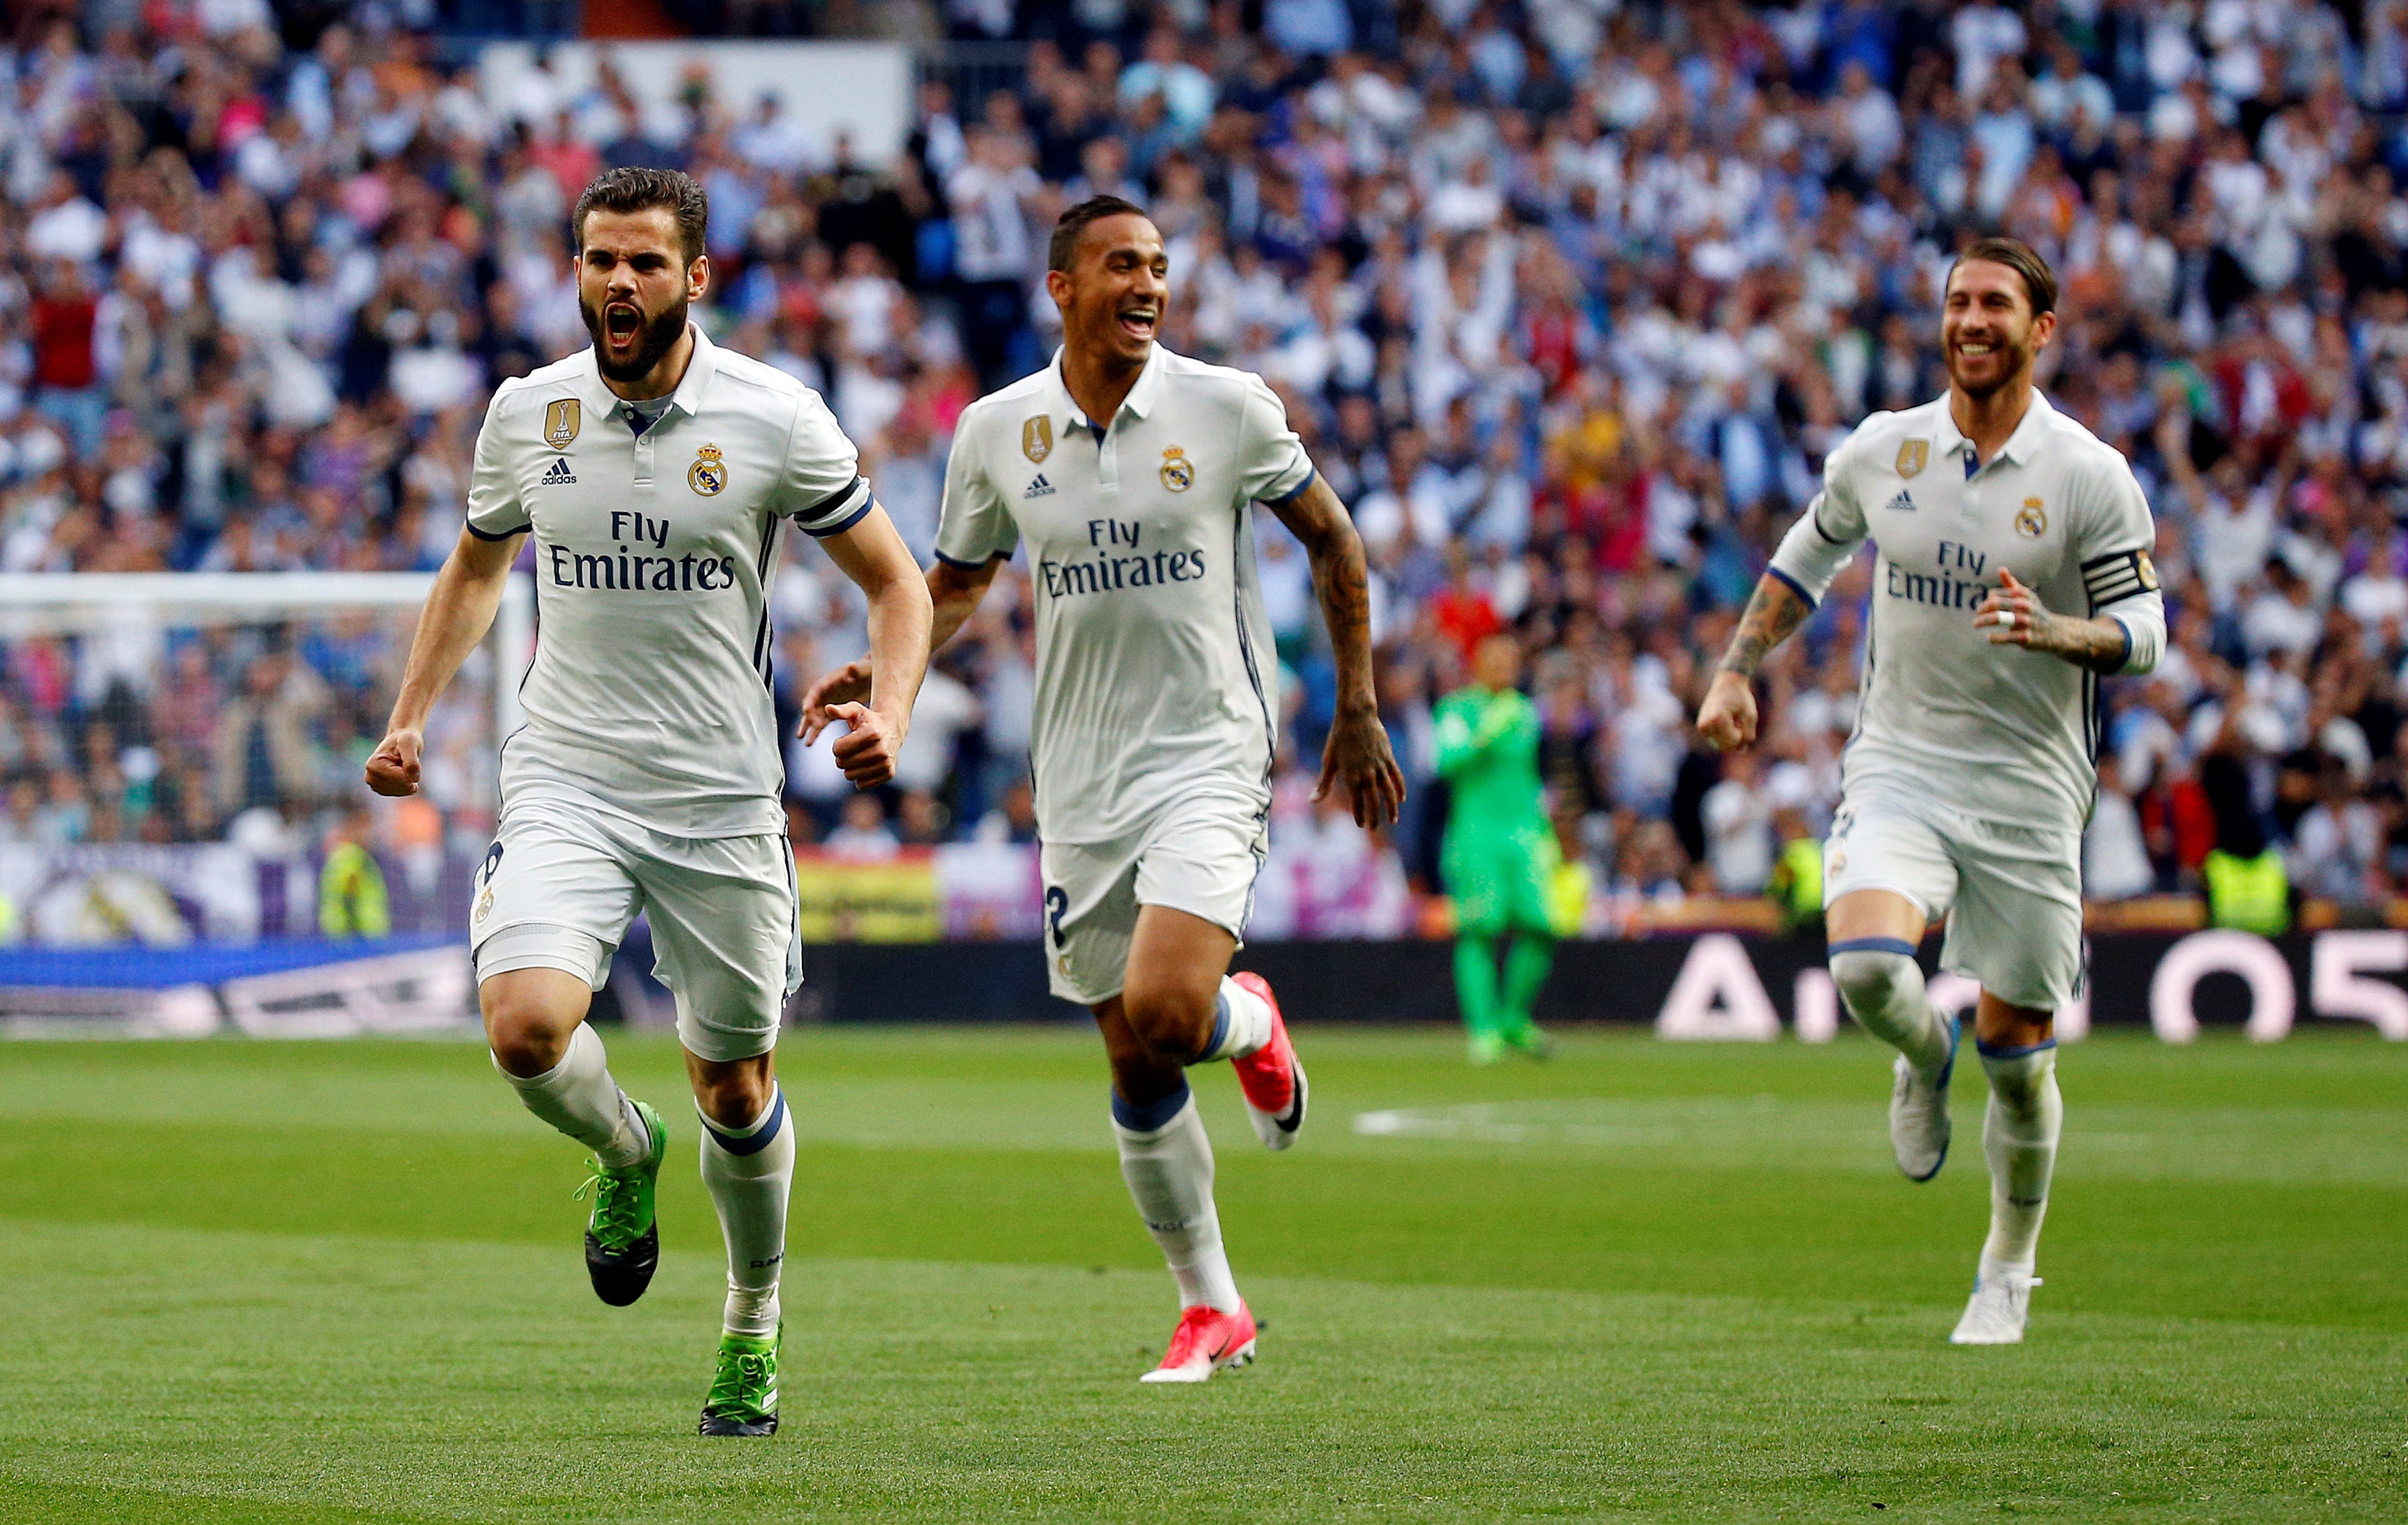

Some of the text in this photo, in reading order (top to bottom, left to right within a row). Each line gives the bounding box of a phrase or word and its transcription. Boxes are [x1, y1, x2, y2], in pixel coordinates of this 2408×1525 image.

[542, 474, 577, 485] adidas
[611, 511, 669, 549] Fly
[1088, 518, 1141, 548] Fly
[549, 544, 734, 591] Emirates
[1040, 549, 1205, 597] Emirates
[1937, 541, 1986, 576] Fly
[1888, 562, 1991, 611] Emira
